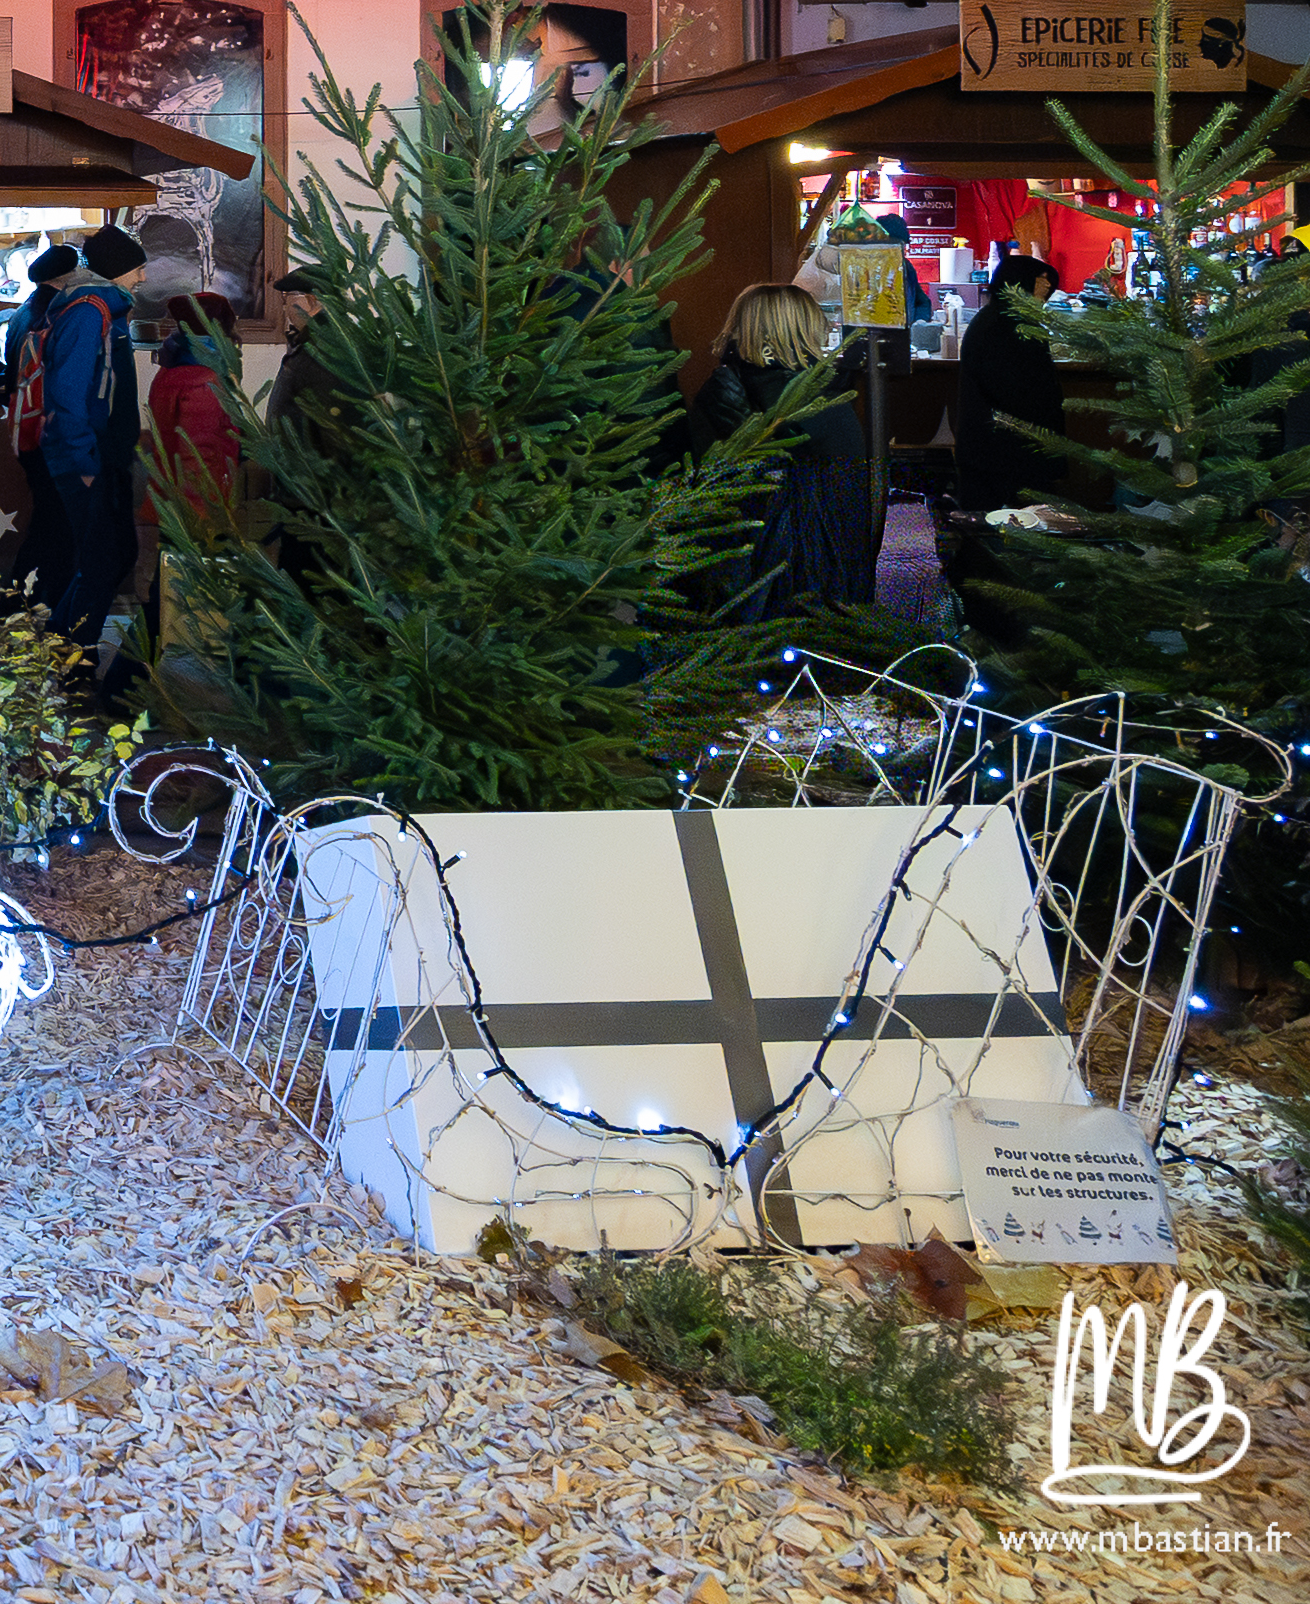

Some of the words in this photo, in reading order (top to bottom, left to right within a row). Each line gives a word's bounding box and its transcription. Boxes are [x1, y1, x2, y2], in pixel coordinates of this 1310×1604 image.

[1017, 51, 1111, 69] SPECIALITES
[1117, 52, 1133, 69] DE
[993, 1147, 1028, 1161] Pour
[1030, 1152, 1071, 1164] votre
[1074, 1150, 1145, 1168] sécurité,
[985, 1164, 1028, 1179] merci
[1029, 1166, 1050, 1181] de
[1053, 1170, 1073, 1181] ne
[1076, 1170, 1105, 1184] pas
[1108, 1170, 1158, 1185] monte
[1011, 1185, 1036, 1197] sur
[1038, 1183, 1063, 1198] les
[1065, 1186, 1154, 1202] structures.
